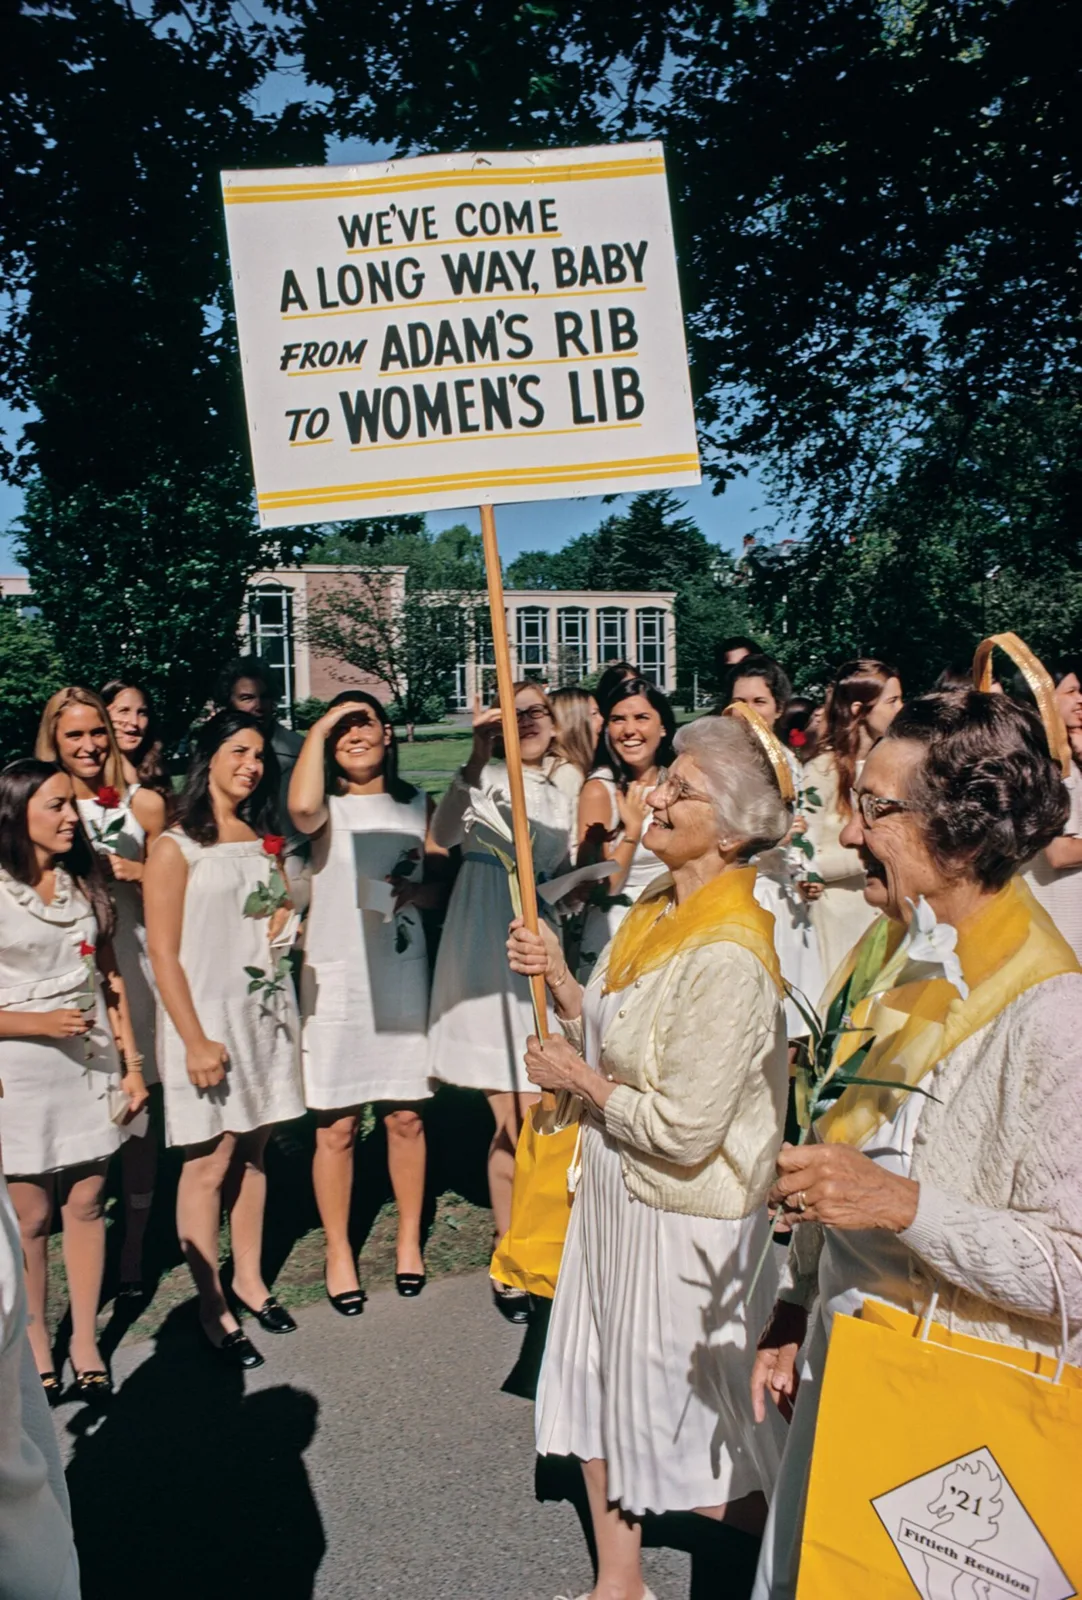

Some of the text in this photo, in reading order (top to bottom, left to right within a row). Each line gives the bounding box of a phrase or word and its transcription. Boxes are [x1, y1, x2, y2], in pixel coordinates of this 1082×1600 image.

[337, 198, 559, 249] WE'VE COME
[280, 240, 648, 313] A LONG WAY, BABY
[279, 306, 639, 372] FROM ADAM'S RIB
[285, 366, 645, 446] TO WOMEN'S LIB
[949, 1485, 983, 1517] '21
[904, 1527, 1031, 1593] Fiftieth Reunion
